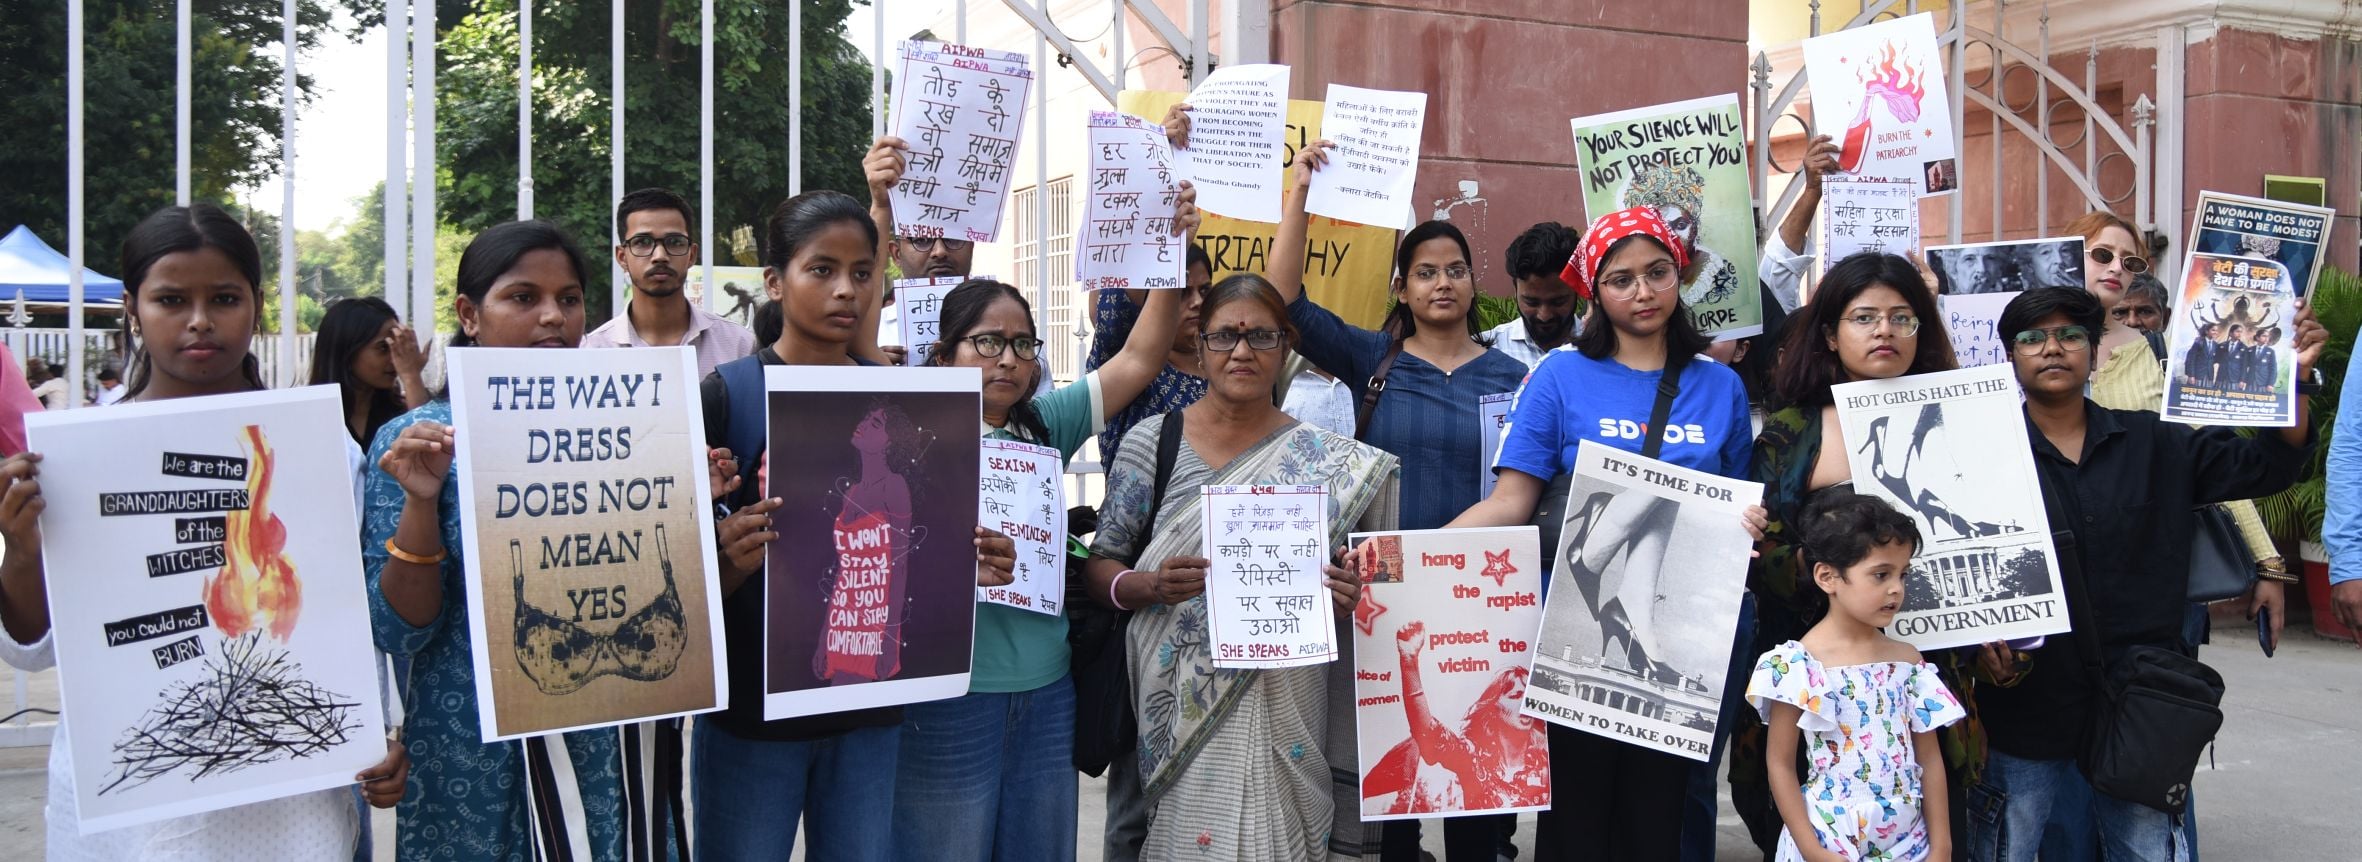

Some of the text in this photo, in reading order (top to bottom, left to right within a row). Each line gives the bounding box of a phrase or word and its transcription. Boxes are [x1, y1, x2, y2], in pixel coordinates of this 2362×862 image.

[941, 43, 985, 58] AIPWA
[952, 58, 989, 72] AIPWA
[922, 66, 1010, 104] तोड़ के
[1190, 107, 1278, 118] ISCOURAGING WOMEN
[1205, 98, 1237, 106] VIOLENT
[918, 99, 1010, 133] रख दो
[1198, 117, 1263, 127] FROM BECOMING
[916, 123, 1013, 159] वो समाज
[1196, 127, 1235, 136] FIGHTERS
[1627, 116, 1694, 148] SILENCE
[1696, 113, 1738, 137] WILL
[1877, 129, 1912, 144] BURN THE
[1098, 143, 1129, 161] हर
[1187, 137, 1227, 146] STRUGGLE
[1248, 141, 1272, 149] THEIR
[1205, 148, 1252, 158] LIBERATION
[1876, 145, 1918, 161] PATRIARCHY
[907, 147, 944, 173] स्त्री
[1227, 160, 1263, 169] SOCIETY.
[1590, 161, 1622, 193] NOT
[1627, 147, 1704, 182] PROTECT
[1148, 161, 1174, 185] के
[1192, 175, 1262, 190] Anuradha Ghandy
[954, 181, 997, 206] है
[1095, 192, 1143, 211] टक्कर
[917, 202, 970, 223] आज
[1834, 200, 1866, 219] महिला
[2206, 205, 2322, 229] A WOMAN DOES NOT
[898, 223, 944, 238] SHE SPEAKS
[1834, 221, 1861, 238] कोई
[2205, 215, 2319, 239] HAVE TO BE MODEST
[1088, 235, 1180, 263] नारा है
[2213, 260, 2249, 275] बेटी की
[1086, 277, 1177, 290] SHE SPEAKS AIPWA
[2213, 272, 2248, 288] देश की
[1952, 312, 1993, 341] Being
[1952, 333, 1962, 345] is
[1955, 346, 1979, 360] act
[1988, 345, 2000, 364] of
[487, 373, 663, 410] THE WAY I
[1846, 393, 1880, 409] HOT
[1882, 389, 1928, 405] GIRLS
[1930, 384, 1972, 400] HATE
[1973, 378, 2008, 394] THE
[526, 426, 632, 464] DRESS
[164, 455, 243, 477] We are the
[988, 457, 1037, 475] SEXISM
[1602, 457, 1734, 503] IT'S TIME FOR
[104, 490, 249, 513] GRANDDAUGHTERS
[495, 475, 675, 519] DOES NOT
[982, 497, 1014, 517] लिए
[177, 521, 225, 541] of the
[833, 523, 891, 550] I WON'T
[1001, 520, 1052, 544] FEMINISM
[539, 529, 643, 570] MEAN
[1258, 544, 1280, 559] पर
[1291, 538, 1319, 558] नहीं
[148, 546, 225, 575] WITCHES
[840, 553, 888, 569] STAY
[1422, 552, 1465, 570] hang
[839, 568, 890, 590] SILENT
[567, 585, 627, 623] YES
[833, 588, 885, 607] SO YOU
[989, 588, 1031, 607] SHE SPEAKS
[1236, 594, 1315, 613] पर सवाल
[1453, 584, 1536, 611] the rapist
[829, 605, 889, 627] CAN STAY
[1240, 611, 1299, 636] उठाओ
[1894, 600, 2056, 638] GOVERNMENT
[109, 609, 203, 646] you could not
[827, 629, 883, 656] COMFORTABLE
[1220, 642, 1329, 658] SHE SPEAKS AIPWA
[1429, 629, 1527, 653] protect the
[155, 637, 204, 669] BURN
[1438, 656, 1490, 673] victim
[1380, 671, 1391, 681] of
[1358, 694, 1400, 707] women
[1524, 697, 1709, 755] WOMEN TO TAKE OVER
